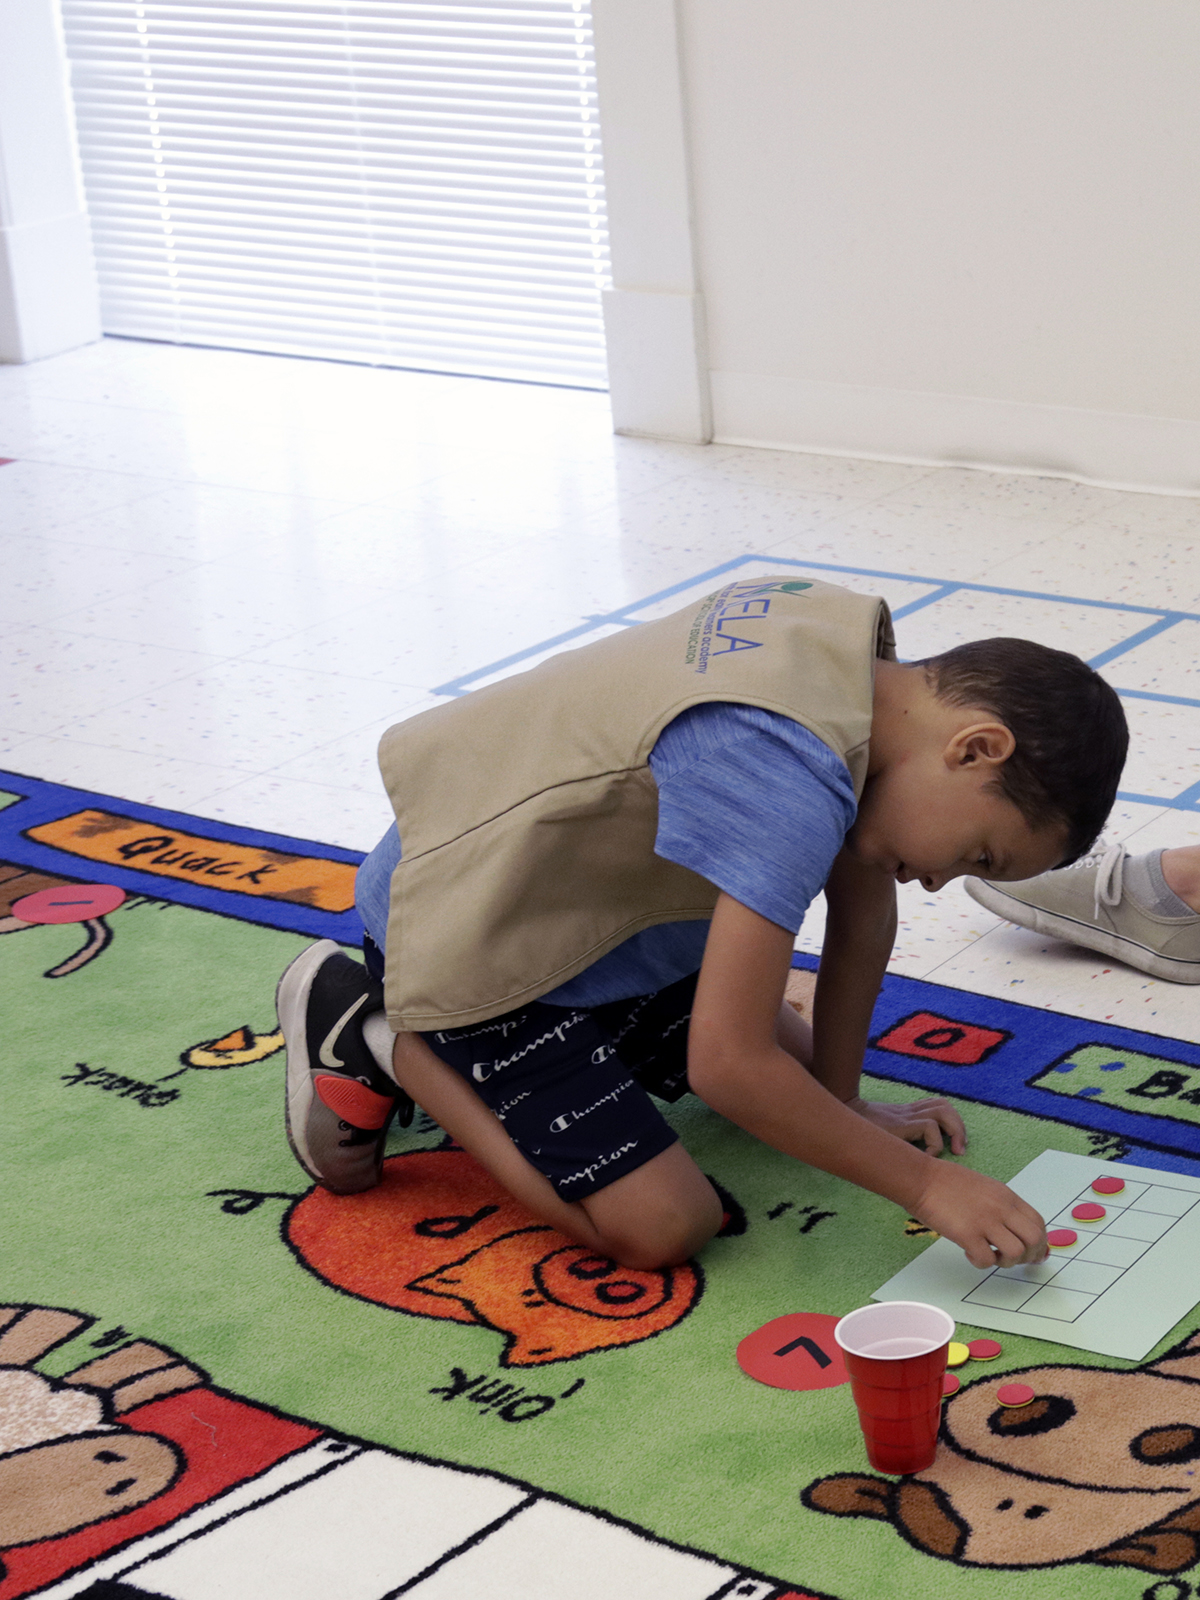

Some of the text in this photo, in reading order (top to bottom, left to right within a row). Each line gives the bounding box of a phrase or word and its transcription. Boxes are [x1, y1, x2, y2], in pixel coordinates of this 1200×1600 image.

[685, 627, 701, 665] EDUCATION
[695, 636, 712, 674] academy
[118, 836, 278, 884] Quack
[60, 1062, 181, 1108] quack
[773, 1336, 832, 1369] 7
[429, 1367, 556, 1423] oink
